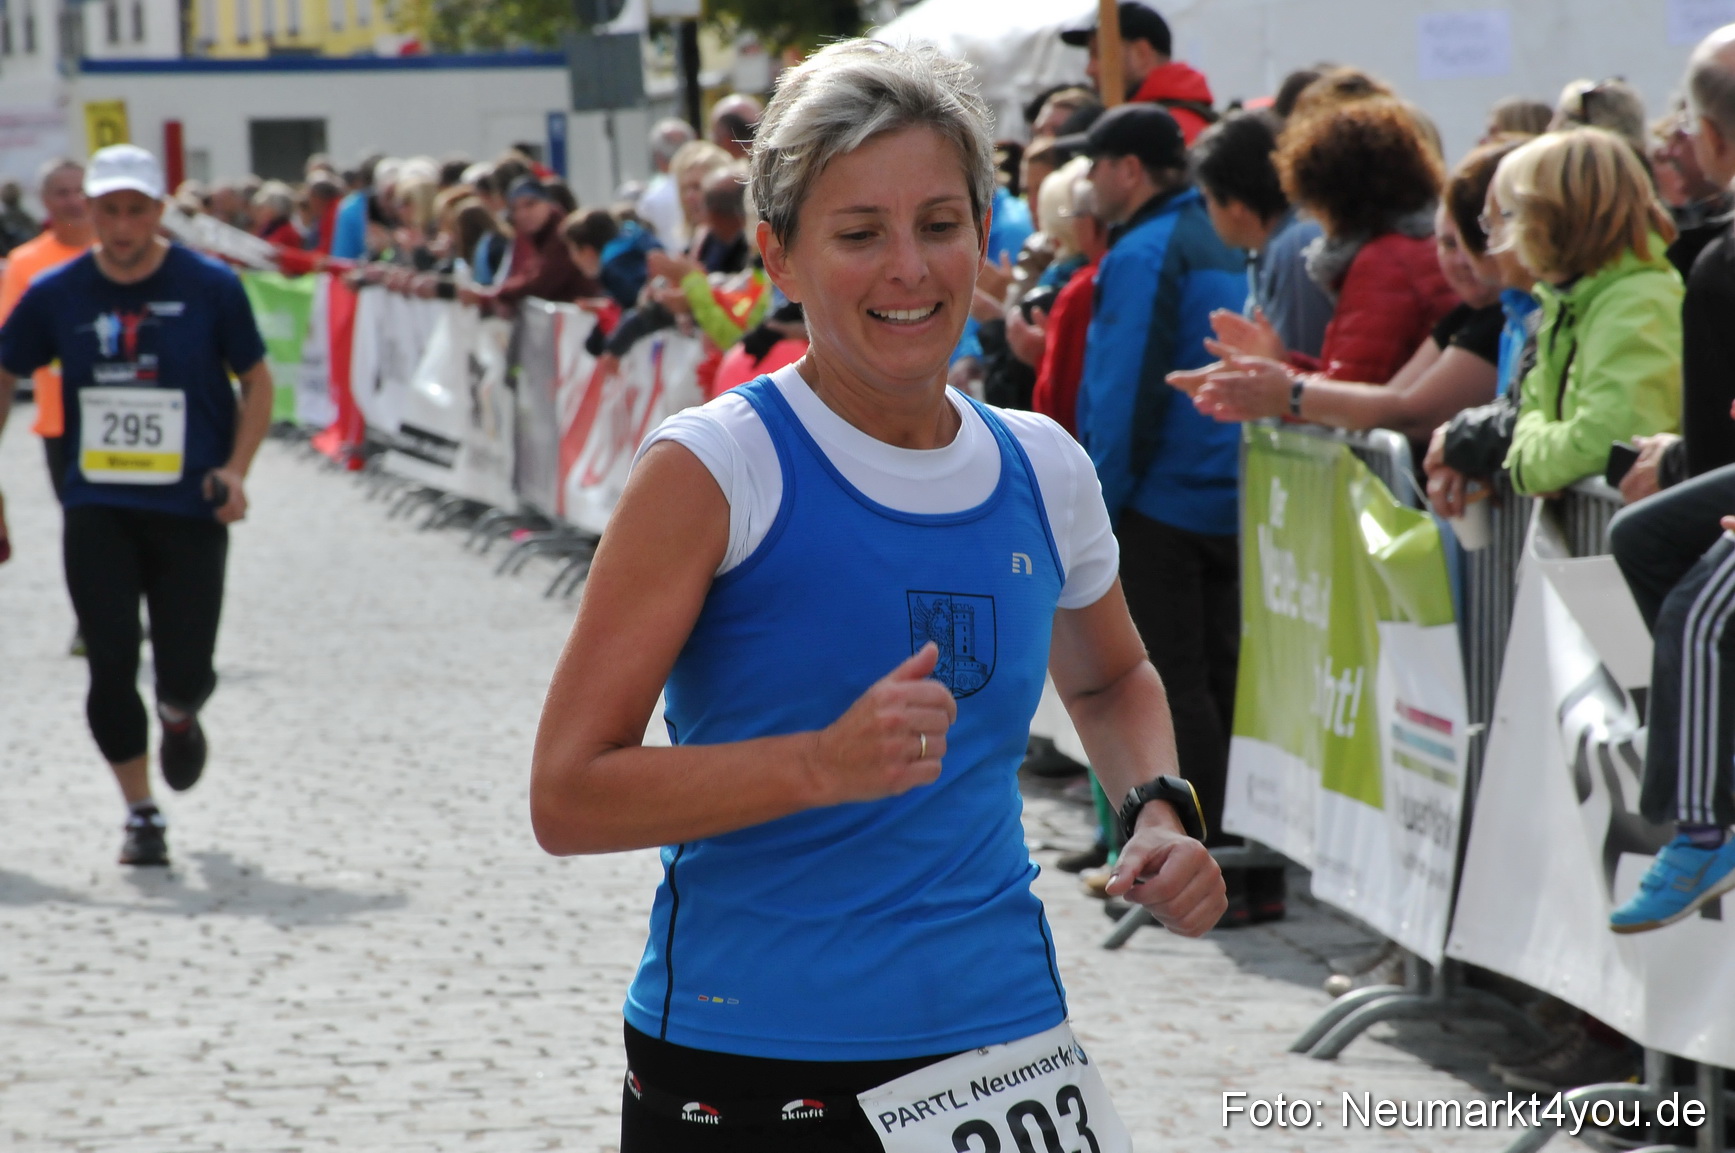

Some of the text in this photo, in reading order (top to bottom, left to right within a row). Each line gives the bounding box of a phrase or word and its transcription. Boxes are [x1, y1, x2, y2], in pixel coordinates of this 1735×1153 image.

[103, 413, 162, 446] 295
[878, 1045, 1075, 1134] PARTL Neumarkt
[681, 1110, 719, 1125] skinfit
[782, 1108, 824, 1121] skinfit
